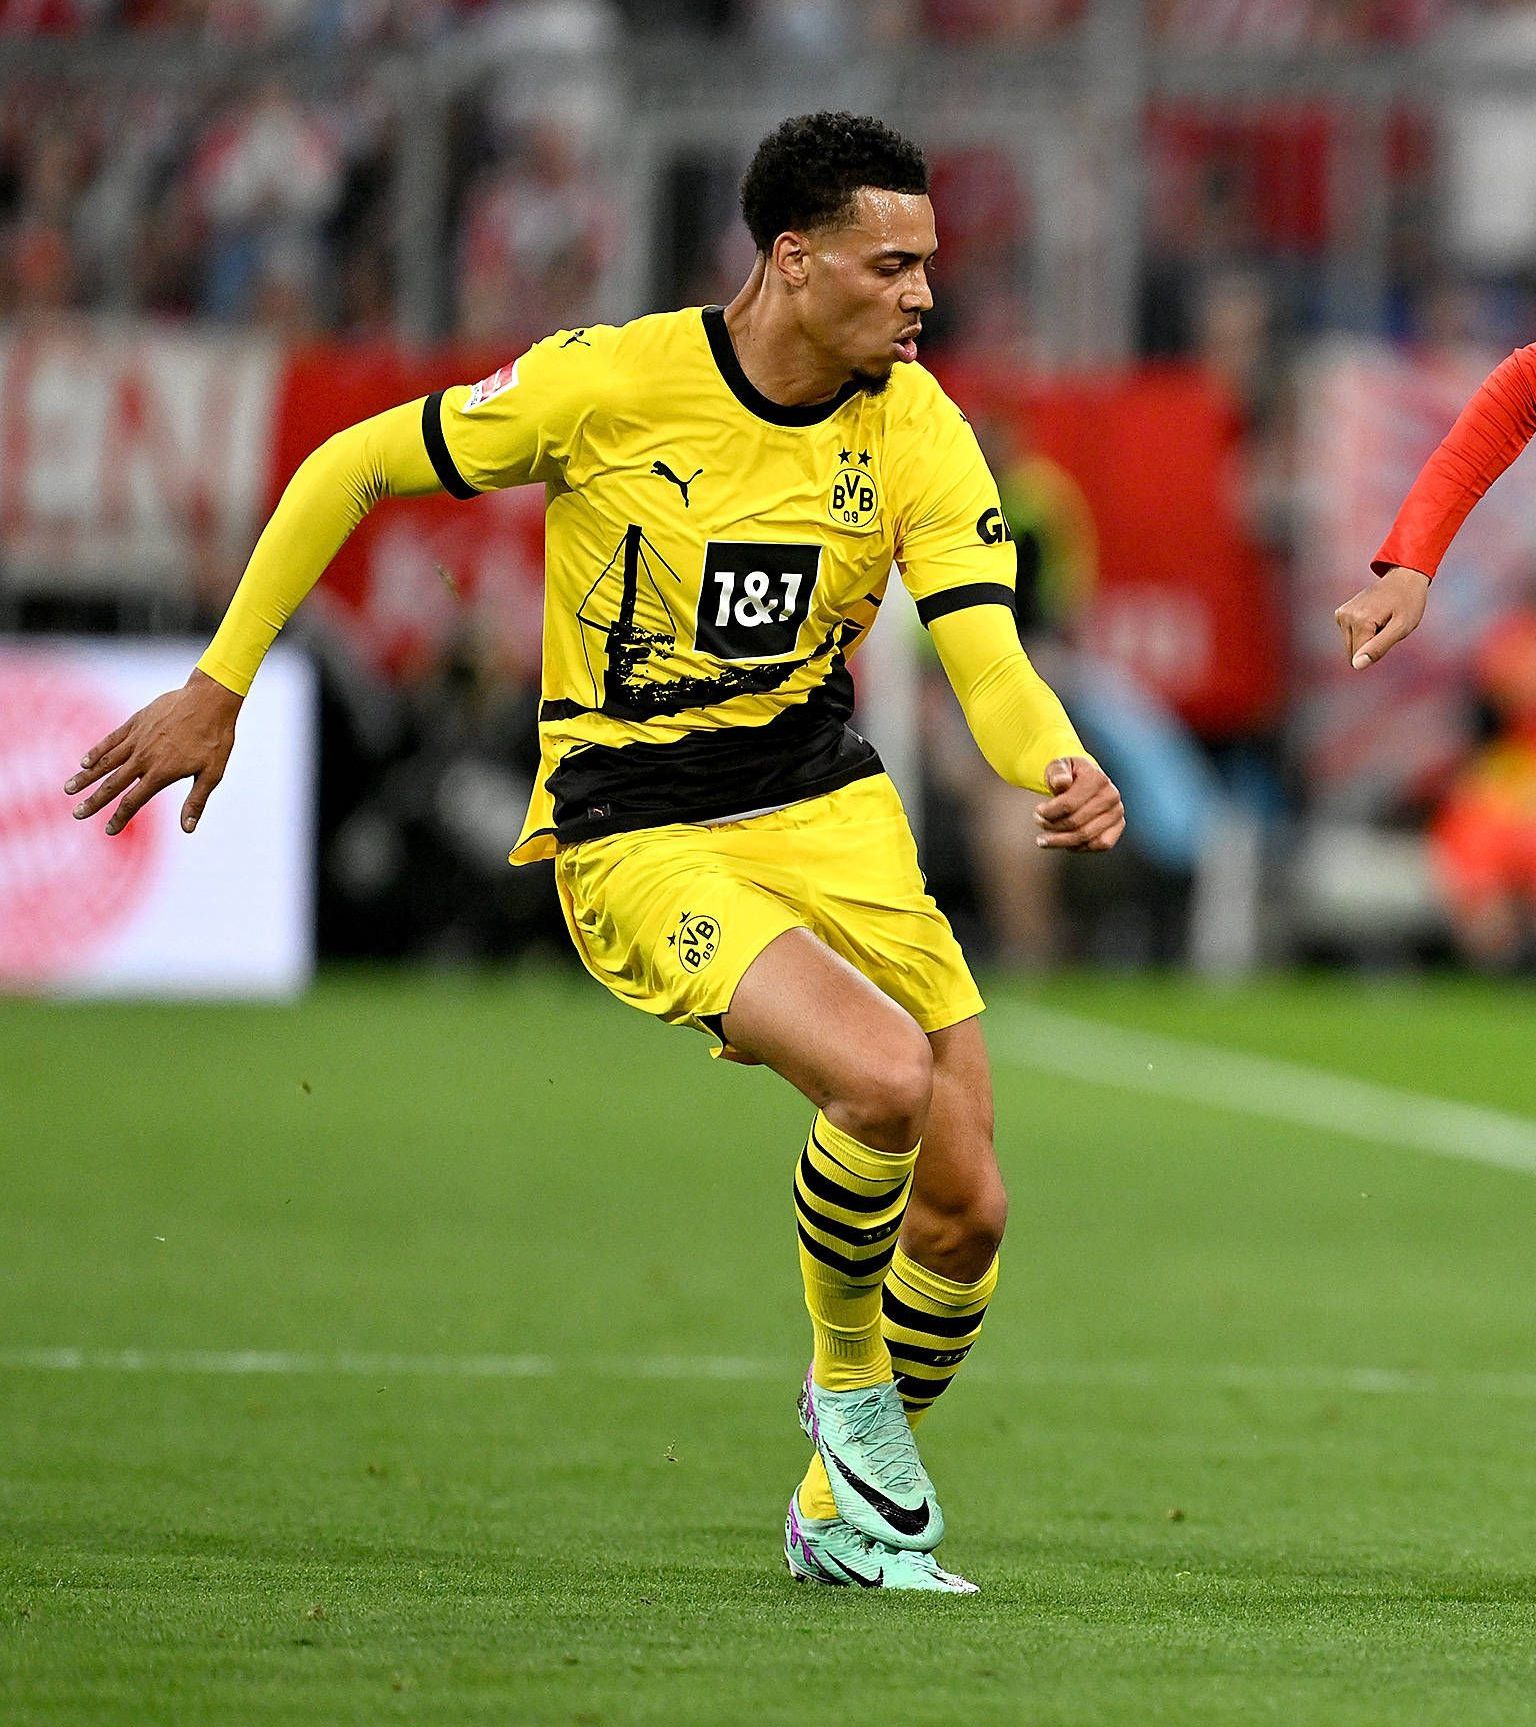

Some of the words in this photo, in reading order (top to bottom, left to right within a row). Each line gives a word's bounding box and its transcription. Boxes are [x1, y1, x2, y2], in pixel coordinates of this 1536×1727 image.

[833, 473, 874, 512] BVB
[843, 510, 859, 523] 09
[714, 570, 803, 627] 1&1
[682, 920, 714, 968] BVB
[702, 942, 715, 960] 09
